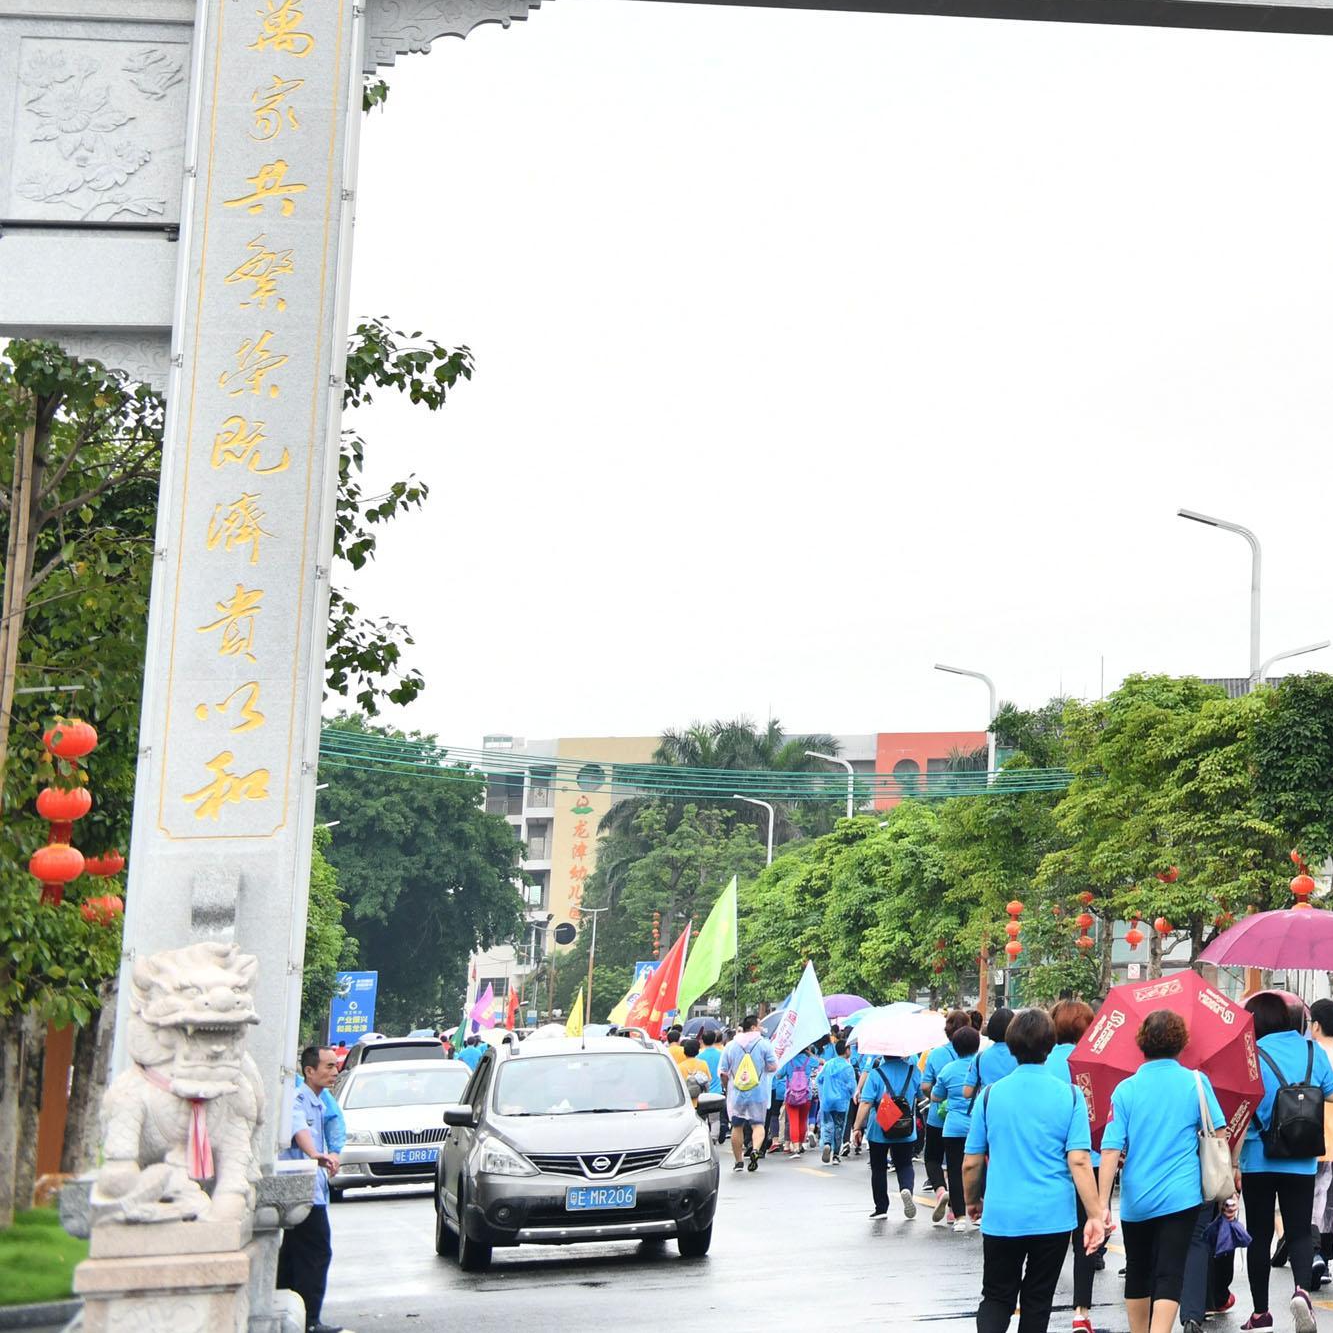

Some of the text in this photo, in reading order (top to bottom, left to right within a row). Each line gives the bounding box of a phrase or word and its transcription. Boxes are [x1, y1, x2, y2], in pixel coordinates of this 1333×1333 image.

[568, 820, 590, 920] 龙津幼儿园
